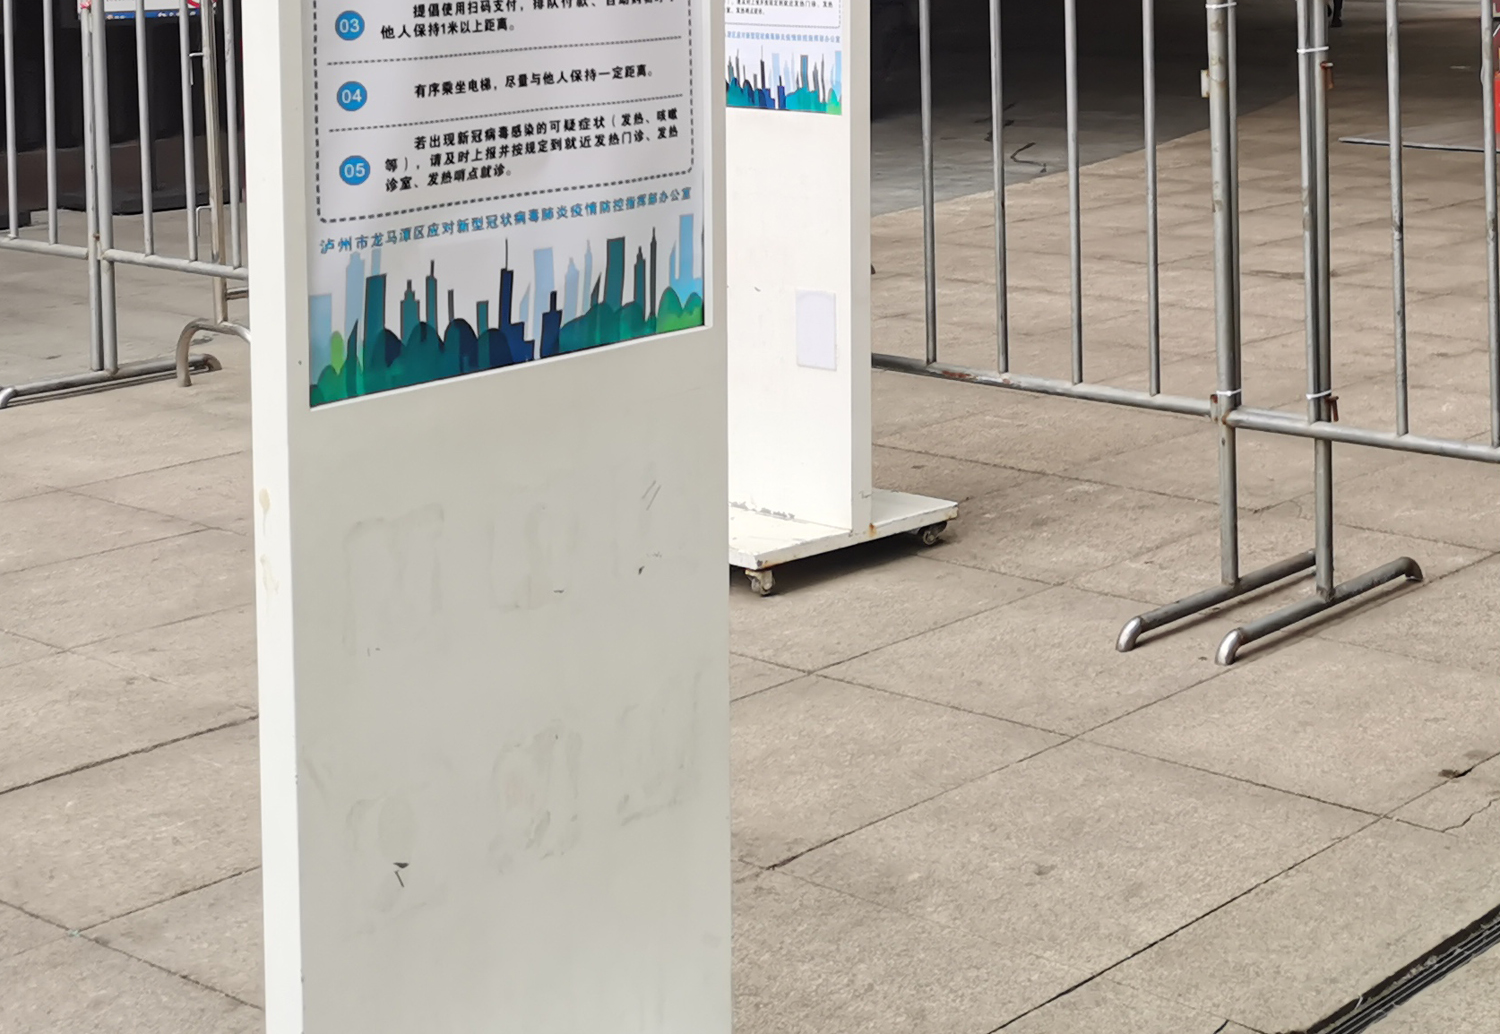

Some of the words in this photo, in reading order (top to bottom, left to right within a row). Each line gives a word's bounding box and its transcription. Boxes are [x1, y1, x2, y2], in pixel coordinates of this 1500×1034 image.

[339, 18, 361, 34] 03
[380, 18, 516, 40] 他人保持1米以上距离。
[341, 89, 363, 105] 04
[344, 163, 366, 179] 05
[319, 187, 693, 255] 泸州市龙马潭区应对新型冠状病毒肺炎疫情防控指挥部办公室
